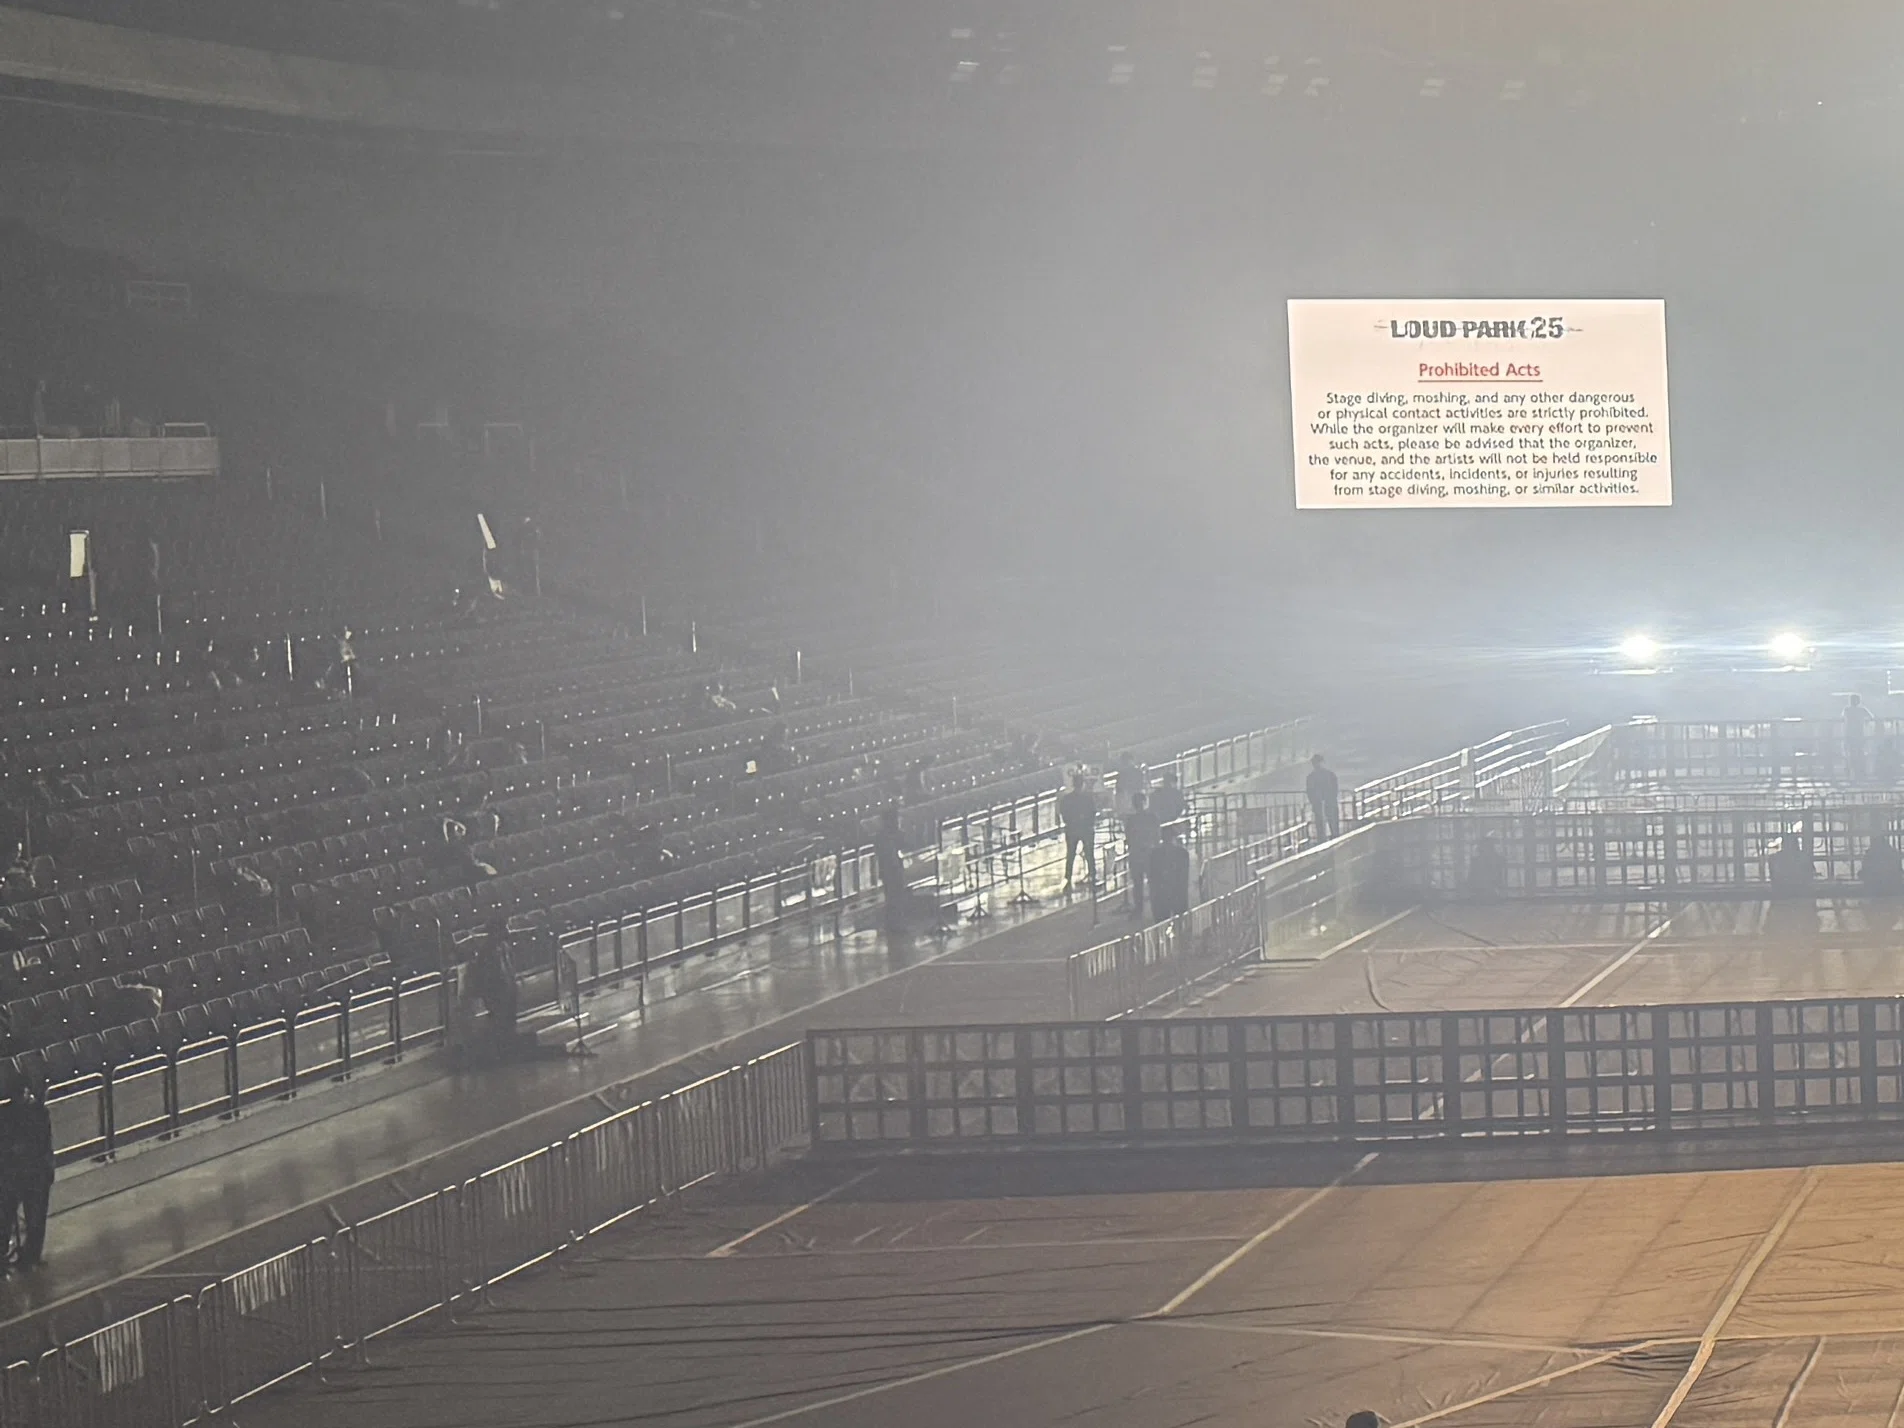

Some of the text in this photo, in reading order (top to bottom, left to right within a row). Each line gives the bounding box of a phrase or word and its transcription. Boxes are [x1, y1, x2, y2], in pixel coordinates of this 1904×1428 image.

[1390, 317, 1563, 338] LOUD PARK 25
[1418, 362, 1541, 377] Prohibited Acts
[1326, 392, 1634, 406] Stage diving, moshing, and any other dangerous
[1317, 405, 1648, 421] or physical contact activities are strictly prohibited.
[1310, 421, 1653, 436] While the organizer will make every effort to prevent
[1328, 437, 1636, 450] such acts, please be advised that the organizer,
[1308, 452, 1657, 465] the venue, and the artists will not be held responsible
[1330, 468, 1637, 482] for any accidents, incidents, or injuries resulting
[1334, 481, 1638, 497] from stage diving, moshing, or similar activities.
